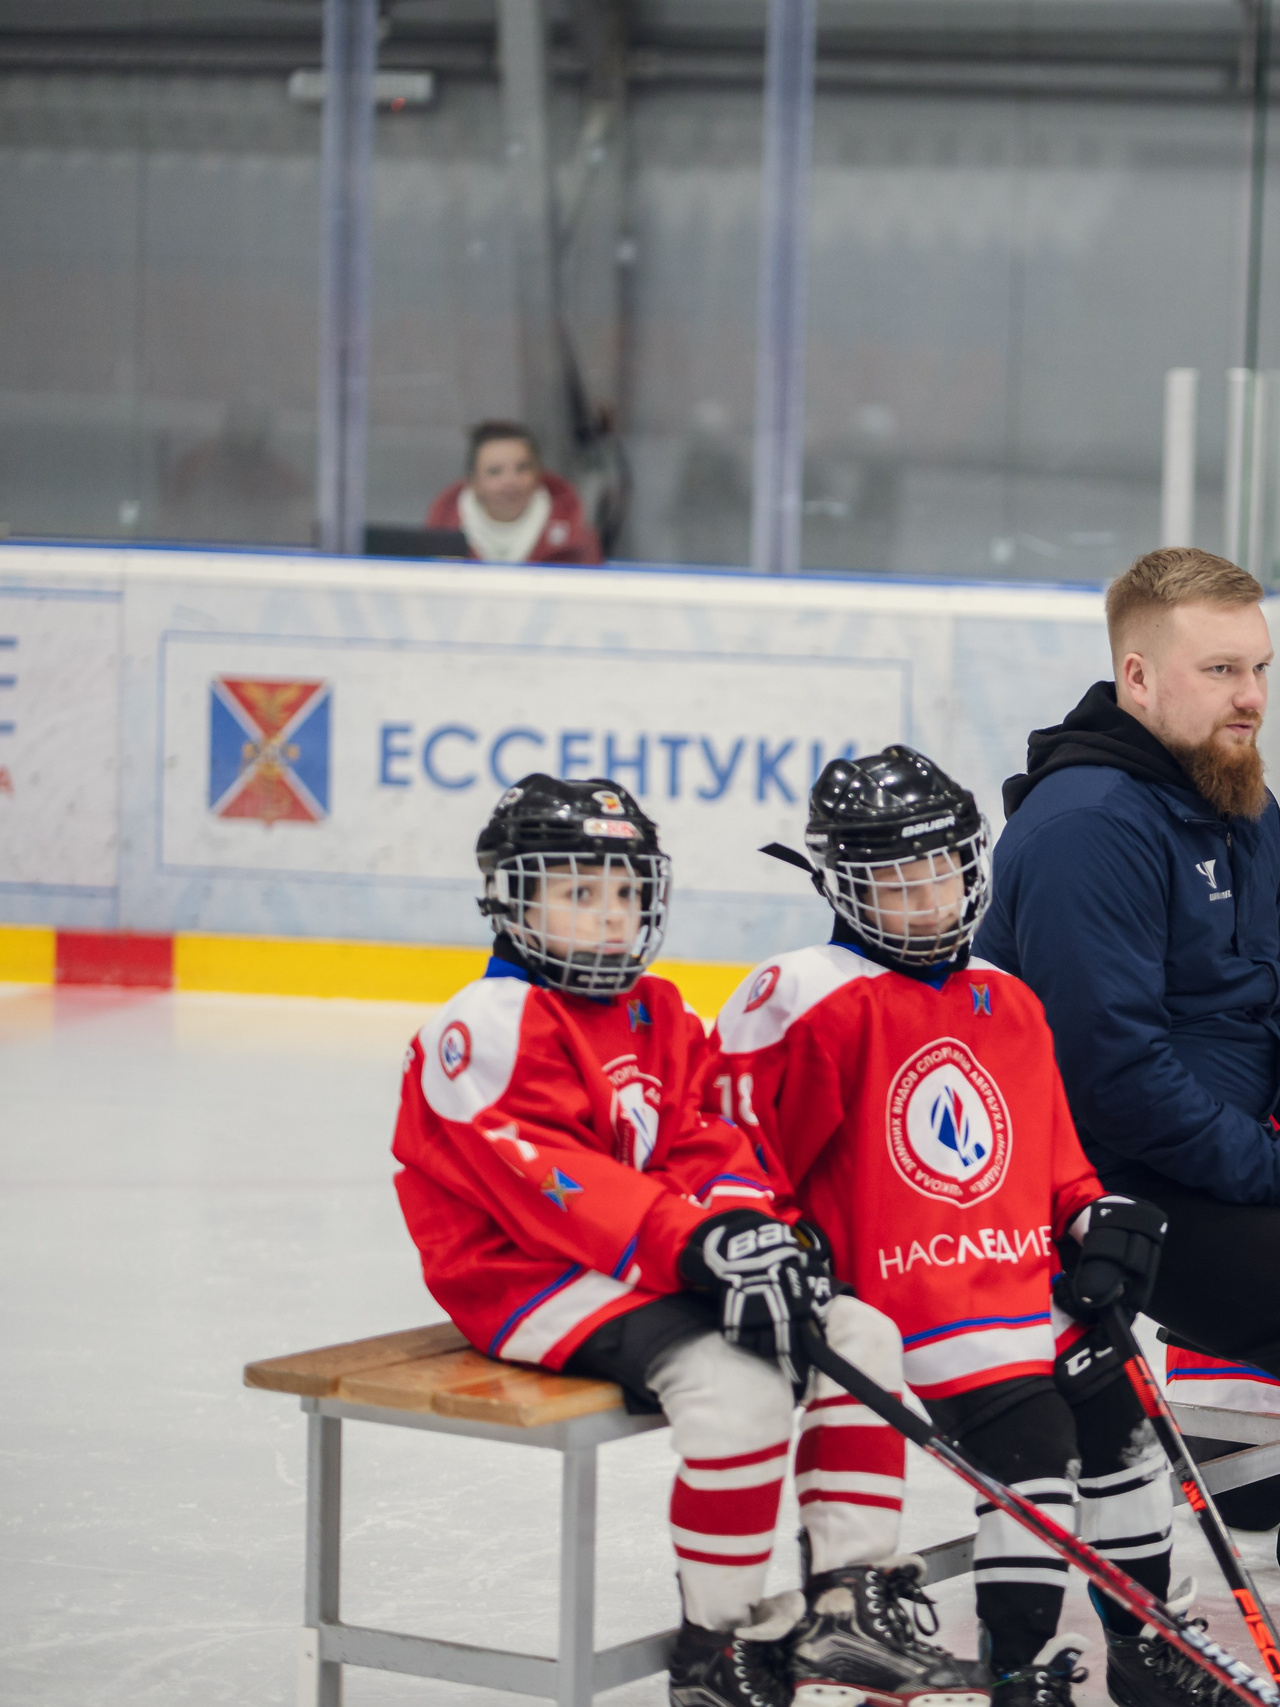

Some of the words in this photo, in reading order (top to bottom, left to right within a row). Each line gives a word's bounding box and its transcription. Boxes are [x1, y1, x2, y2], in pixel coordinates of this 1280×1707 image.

[901, 815, 956, 838] BAUER
[892, 1070, 919, 1115] ВИДОВ
[878, 1225, 1052, 1280] НАСЛЕДИЕ
